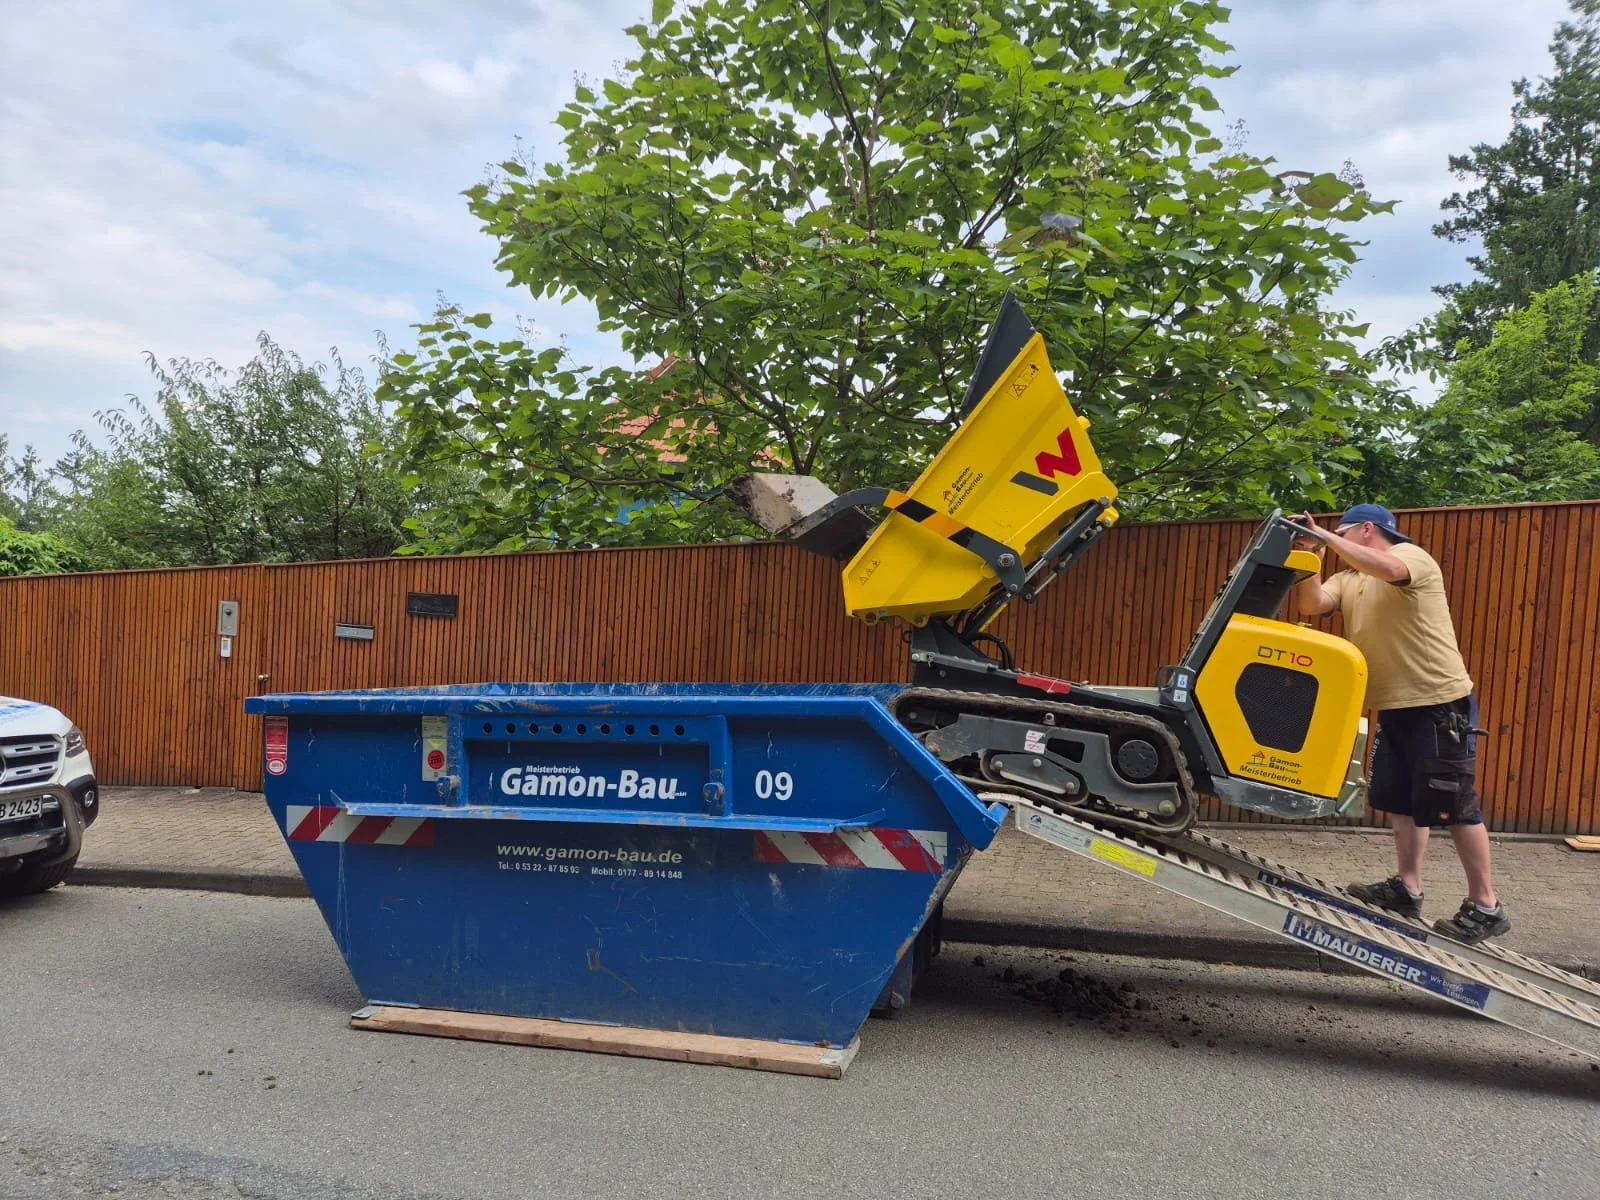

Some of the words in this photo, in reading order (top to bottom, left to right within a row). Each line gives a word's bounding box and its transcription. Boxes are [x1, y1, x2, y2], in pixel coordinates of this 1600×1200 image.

[525, 765, 581, 774] Meisterbetrieb
[1239, 764, 1303, 785] Meisterbetrieb
[500, 767, 678, 800] Gamon-Bau
[754, 769, 794, 801] 09
[8, 798, 40, 817] 2423
[497, 845, 683, 864] www.gamon-bau.de
[533, 864, 542, 872] 22
[656, 870, 666, 879] 14
[1312, 930, 1422, 983] MAUDERER
